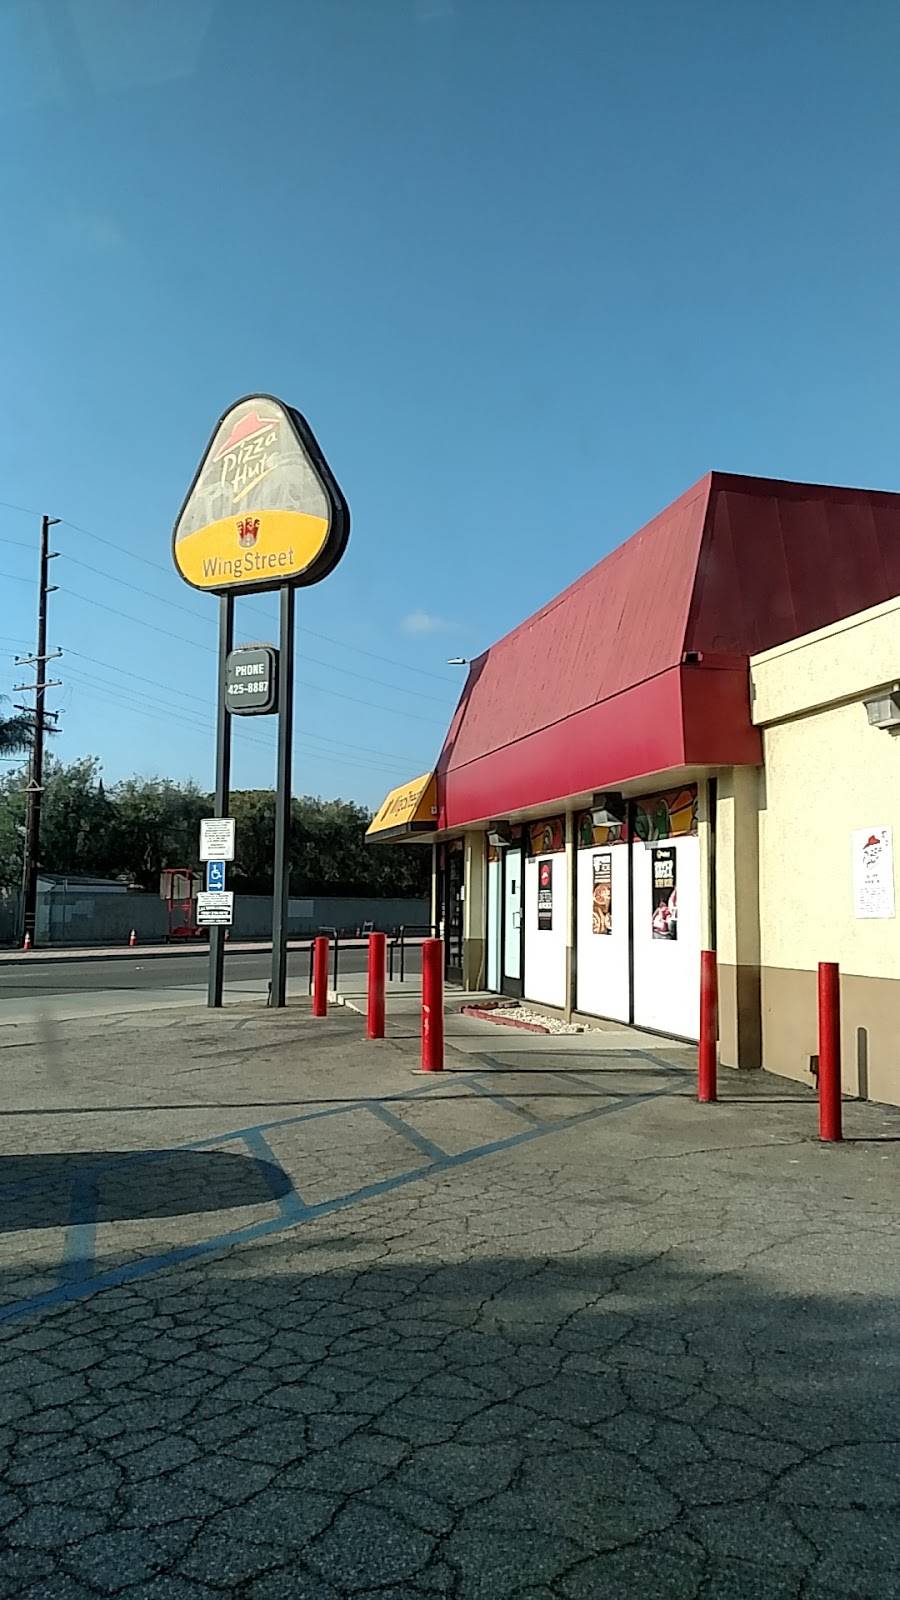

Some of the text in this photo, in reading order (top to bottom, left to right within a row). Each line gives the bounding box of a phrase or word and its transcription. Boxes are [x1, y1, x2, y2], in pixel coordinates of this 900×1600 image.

[221, 431, 277, 488] Pizza
[232, 453, 279, 491] Hut
[203, 549, 294, 577] WingStreet
[235, 663, 264, 676] PHONE
